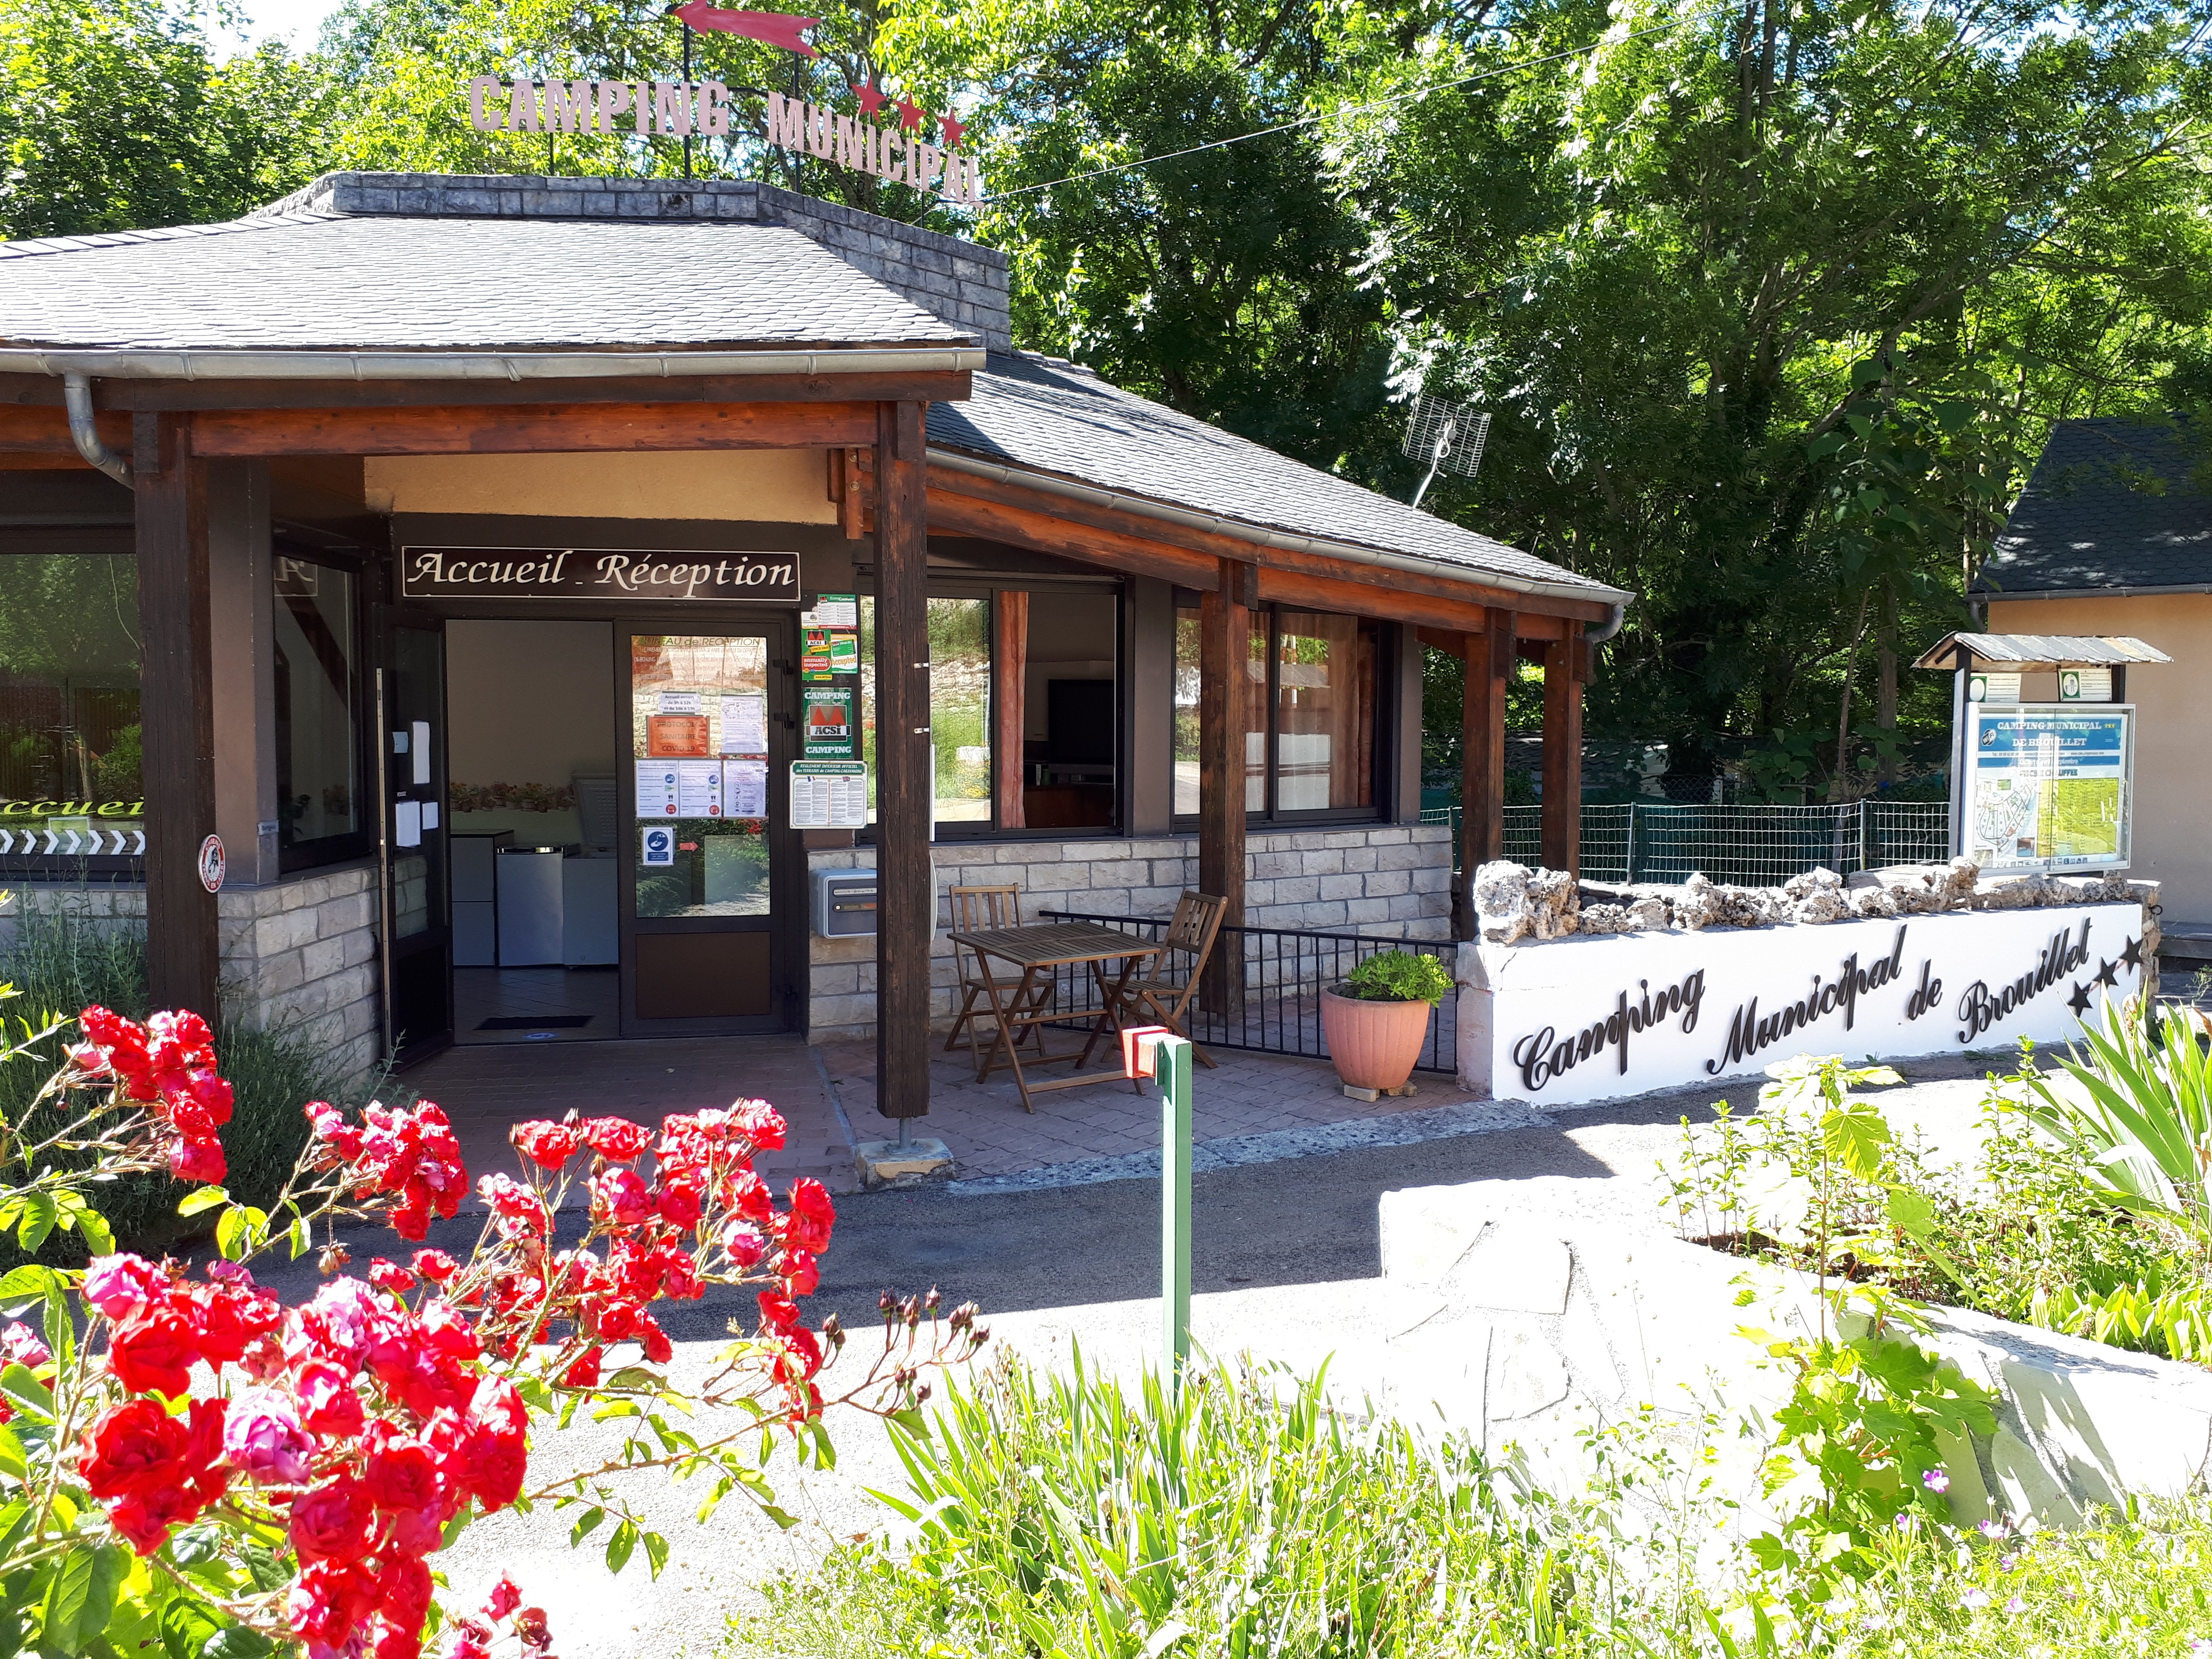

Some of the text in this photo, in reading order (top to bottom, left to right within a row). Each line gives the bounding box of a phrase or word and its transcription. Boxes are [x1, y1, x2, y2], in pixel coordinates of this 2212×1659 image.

[470, 76, 984, 209] CAMPING MUNICIPAL
[407, 550, 574, 583] Accueil
[594, 554, 795, 598] Réception
[639, 637, 682, 646] BUREAU
[2046, 721, 2102, 730] MUNICIPAL
[2012, 738, 2087, 747] DE BROUILLET
[0, 796, 144, 815] ccuei
[205, 838, 221, 851] CHIENS
[1513, 917, 2093, 1092] Camping Municipal de Brouillet
